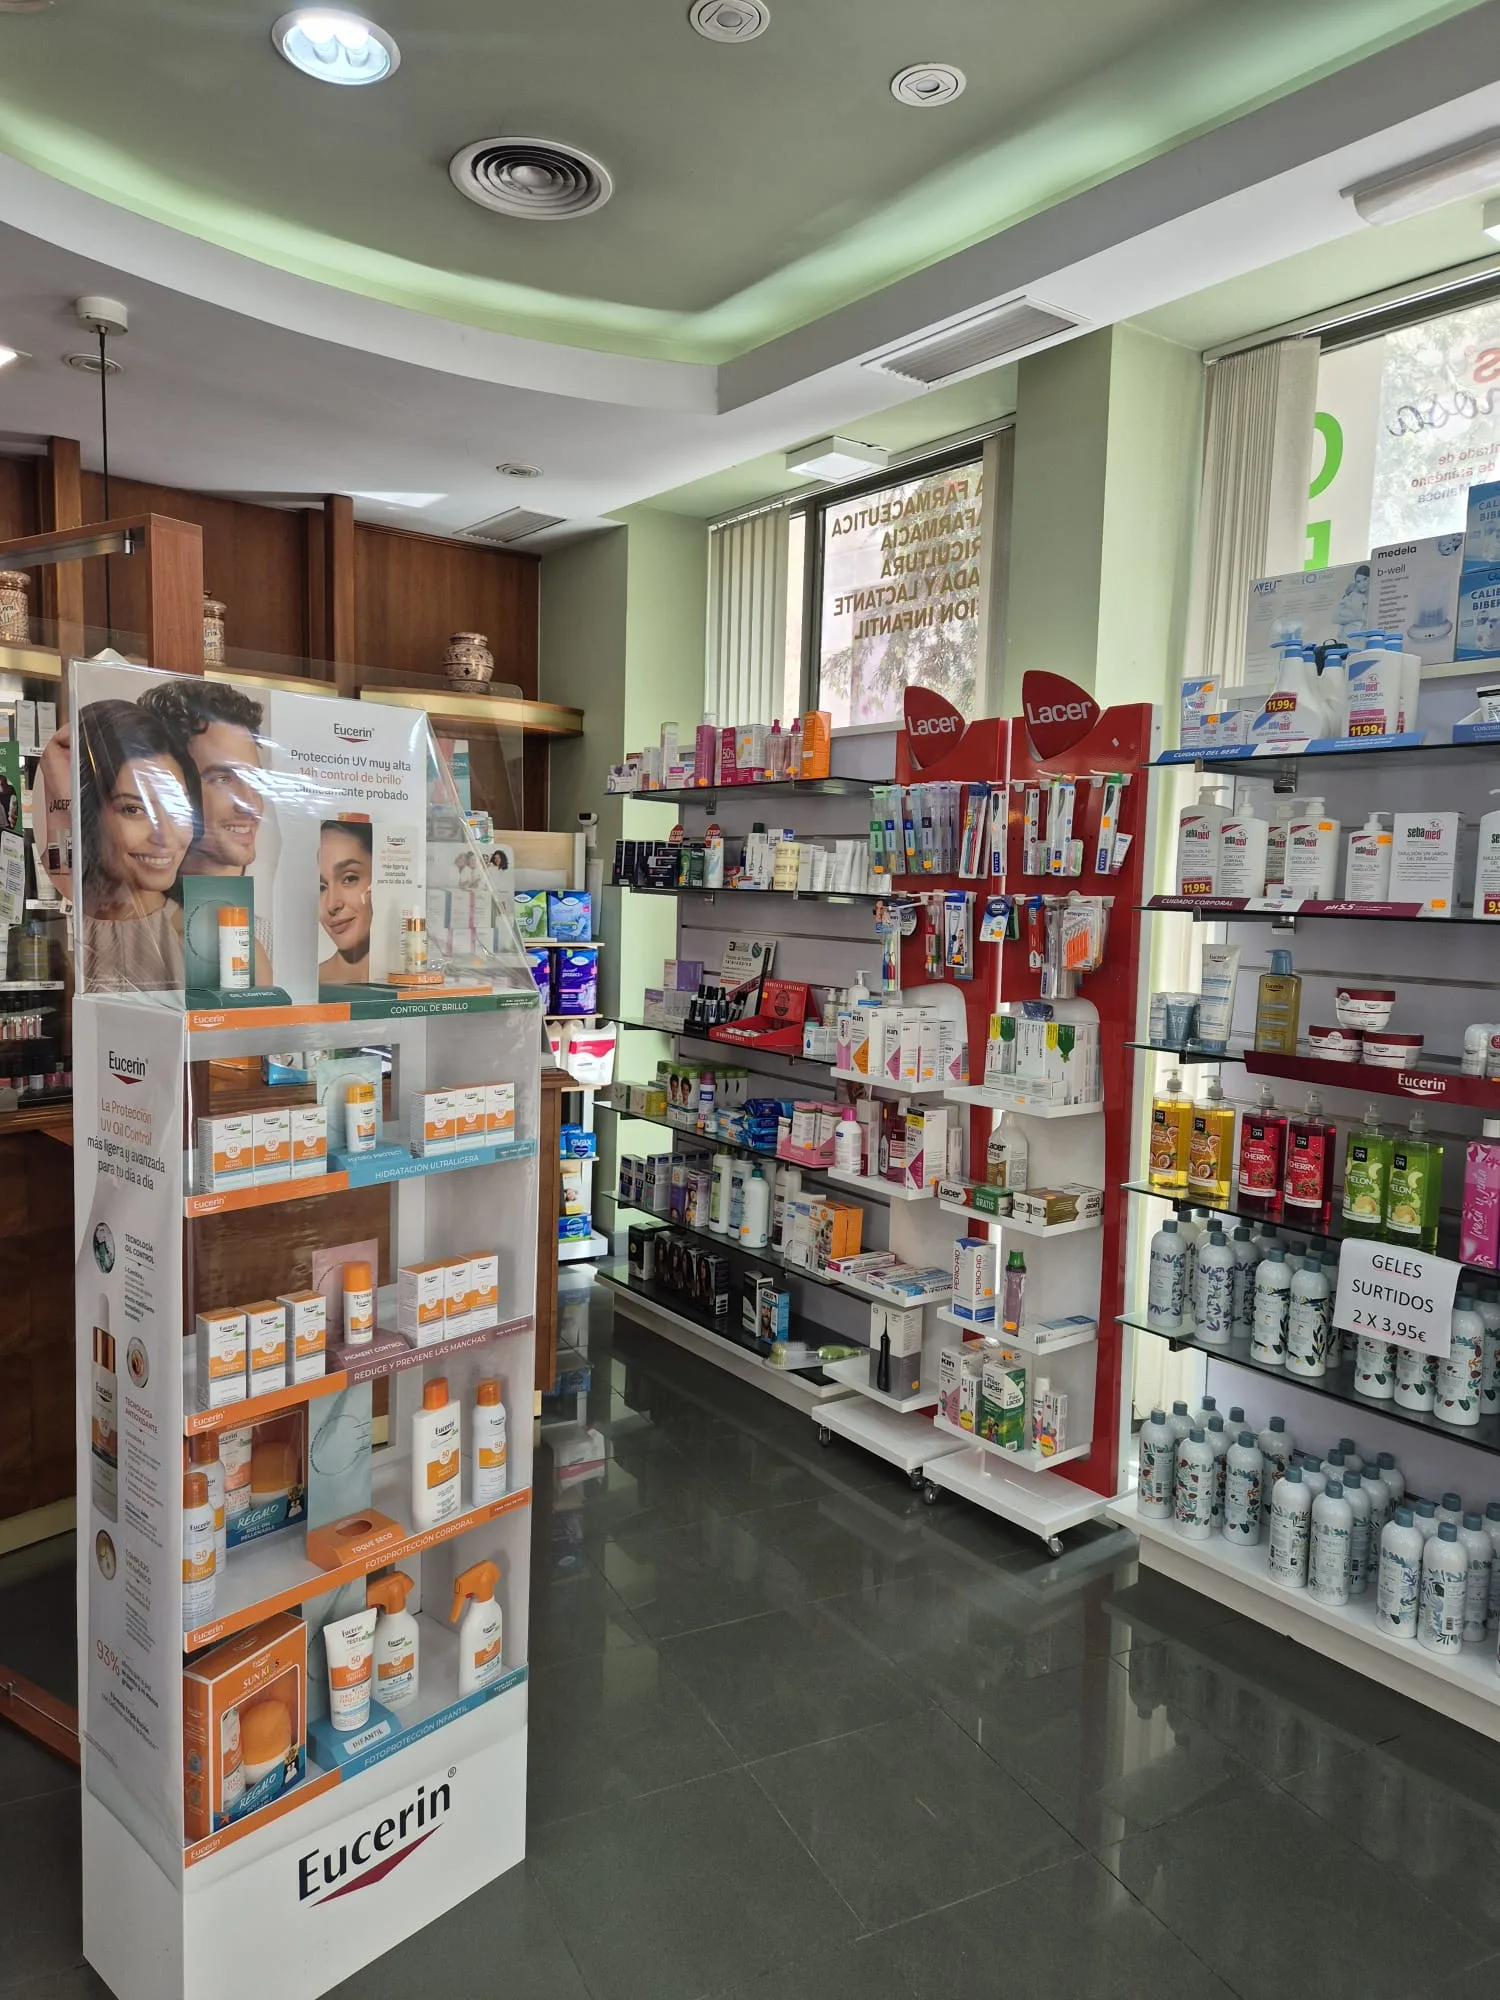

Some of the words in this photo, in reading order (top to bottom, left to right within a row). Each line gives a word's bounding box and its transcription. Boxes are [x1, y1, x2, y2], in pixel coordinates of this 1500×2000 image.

[1377, 546, 1417, 559] medela
[1377, 564, 1406, 577] b-well
[1026, 701, 1093, 724] Lacer
[1266, 699, 1295, 711] 11,99€
[334, 723, 372, 739] Eucerin
[908, 715, 959, 736] Lacer
[1350, 724, 1383, 736] 11,99€
[291, 750, 350, 765] Protección
[352, 756, 367, 767] UV
[369, 760, 391, 771] muy
[393, 760, 411, 771] alta
[722, 748, 736, 760] 50%
[321, 770, 359, 783] control
[361, 772, 374, 783] de
[366, 788, 409, 801] probado
[1407, 827, 1443, 840] sebamed
[1183, 883, 1211, 895] 11,99€
[1338, 904, 1355, 912] 5.5
[391, 1004, 428, 1015] CONTROL
[429, 1004, 440, 1012] DE
[442, 1003, 469, 1011] BRILLO
[193, 1014, 225, 1025] Eucerin
[109, 1051, 146, 1077] Eucerin
[1397, 1073, 1447, 1091] Eucerin
[101, 1098, 110, 1112] La
[111, 1101, 152, 1124] Protección
[101, 1117, 112, 1131] UV
[112, 1121, 124, 1136] Oil
[125, 1125, 152, 1146] Control
[571, 1138, 592, 1147] evax
[88, 1136, 103, 1150] más
[104, 1139, 124, 1157] ligera
[125, 1151, 130, 1162] y
[131, 1151, 165, 1173] avanzada
[430, 1155, 479, 1169] ULTRALIGERA
[1244, 1153, 1271, 1162] CHERRY
[1289, 1162, 1315, 1171] CHERRY
[98, 1161, 115, 1174] para
[116, 1166, 124, 1178] tu
[125, 1167, 135, 1183] día
[142, 1175, 154, 1190] día
[940, 1186, 961, 1198] Lacer
[193, 1198, 225, 1210] Eucerin
[976, 1197, 995, 1210] GRATIS
[125, 1233, 154, 1252] TECNOLOGÍA
[133, 1249, 154, 1264] CONTROL
[1372, 1254, 1423, 1278] GELES
[1352, 1279, 1434, 1313] SURTIDOS
[1353, 1309, 1362, 1324] 2
[1367, 1313, 1377, 1328] X
[1382, 1317, 1427, 1342] 3,95€
[344, 1348, 373, 1361] PIGMENT
[374, 1341, 404, 1353] CONTROL
[354, 1365, 387, 1380] REDUCE
[389, 1362, 396, 1370] Y
[396, 1352, 433, 1367] PREVIENE
[435, 1347, 449, 1356] LAS
[450, 1335, 486, 1351] MANCHAS
[984, 1382, 1003, 1393] Lacer
[125, 1408, 158, 1434] ANTIOXIDANTE
[193, 1413, 224, 1428] Eucerin
[435, 1421, 454, 1435] Eucerin
[238, 1504, 279, 1528] REGALO
[190, 1520, 210, 1531] Eucerin
[435, 1518, 474, 1540] CORPORAL
[353, 1540, 374, 1553] TOQUE
[376, 1532, 393, 1543] SECO
[193, 1624, 225, 1642] Eucerin
[341, 1625, 363, 1638] Eucerin
[97, 1639, 120, 1676] 93%
[351, 1655, 361, 1664] 50
[243, 1672, 260, 1689] SUN
[436, 1705, 469, 1726] INFANTIL
[352, 1728, 384, 1749] INFANTIL
[239, 1773, 277, 1810] REGALO
[191, 1837, 222, 1859] Eucerin
[298, 1783, 451, 1902] Eucerin
